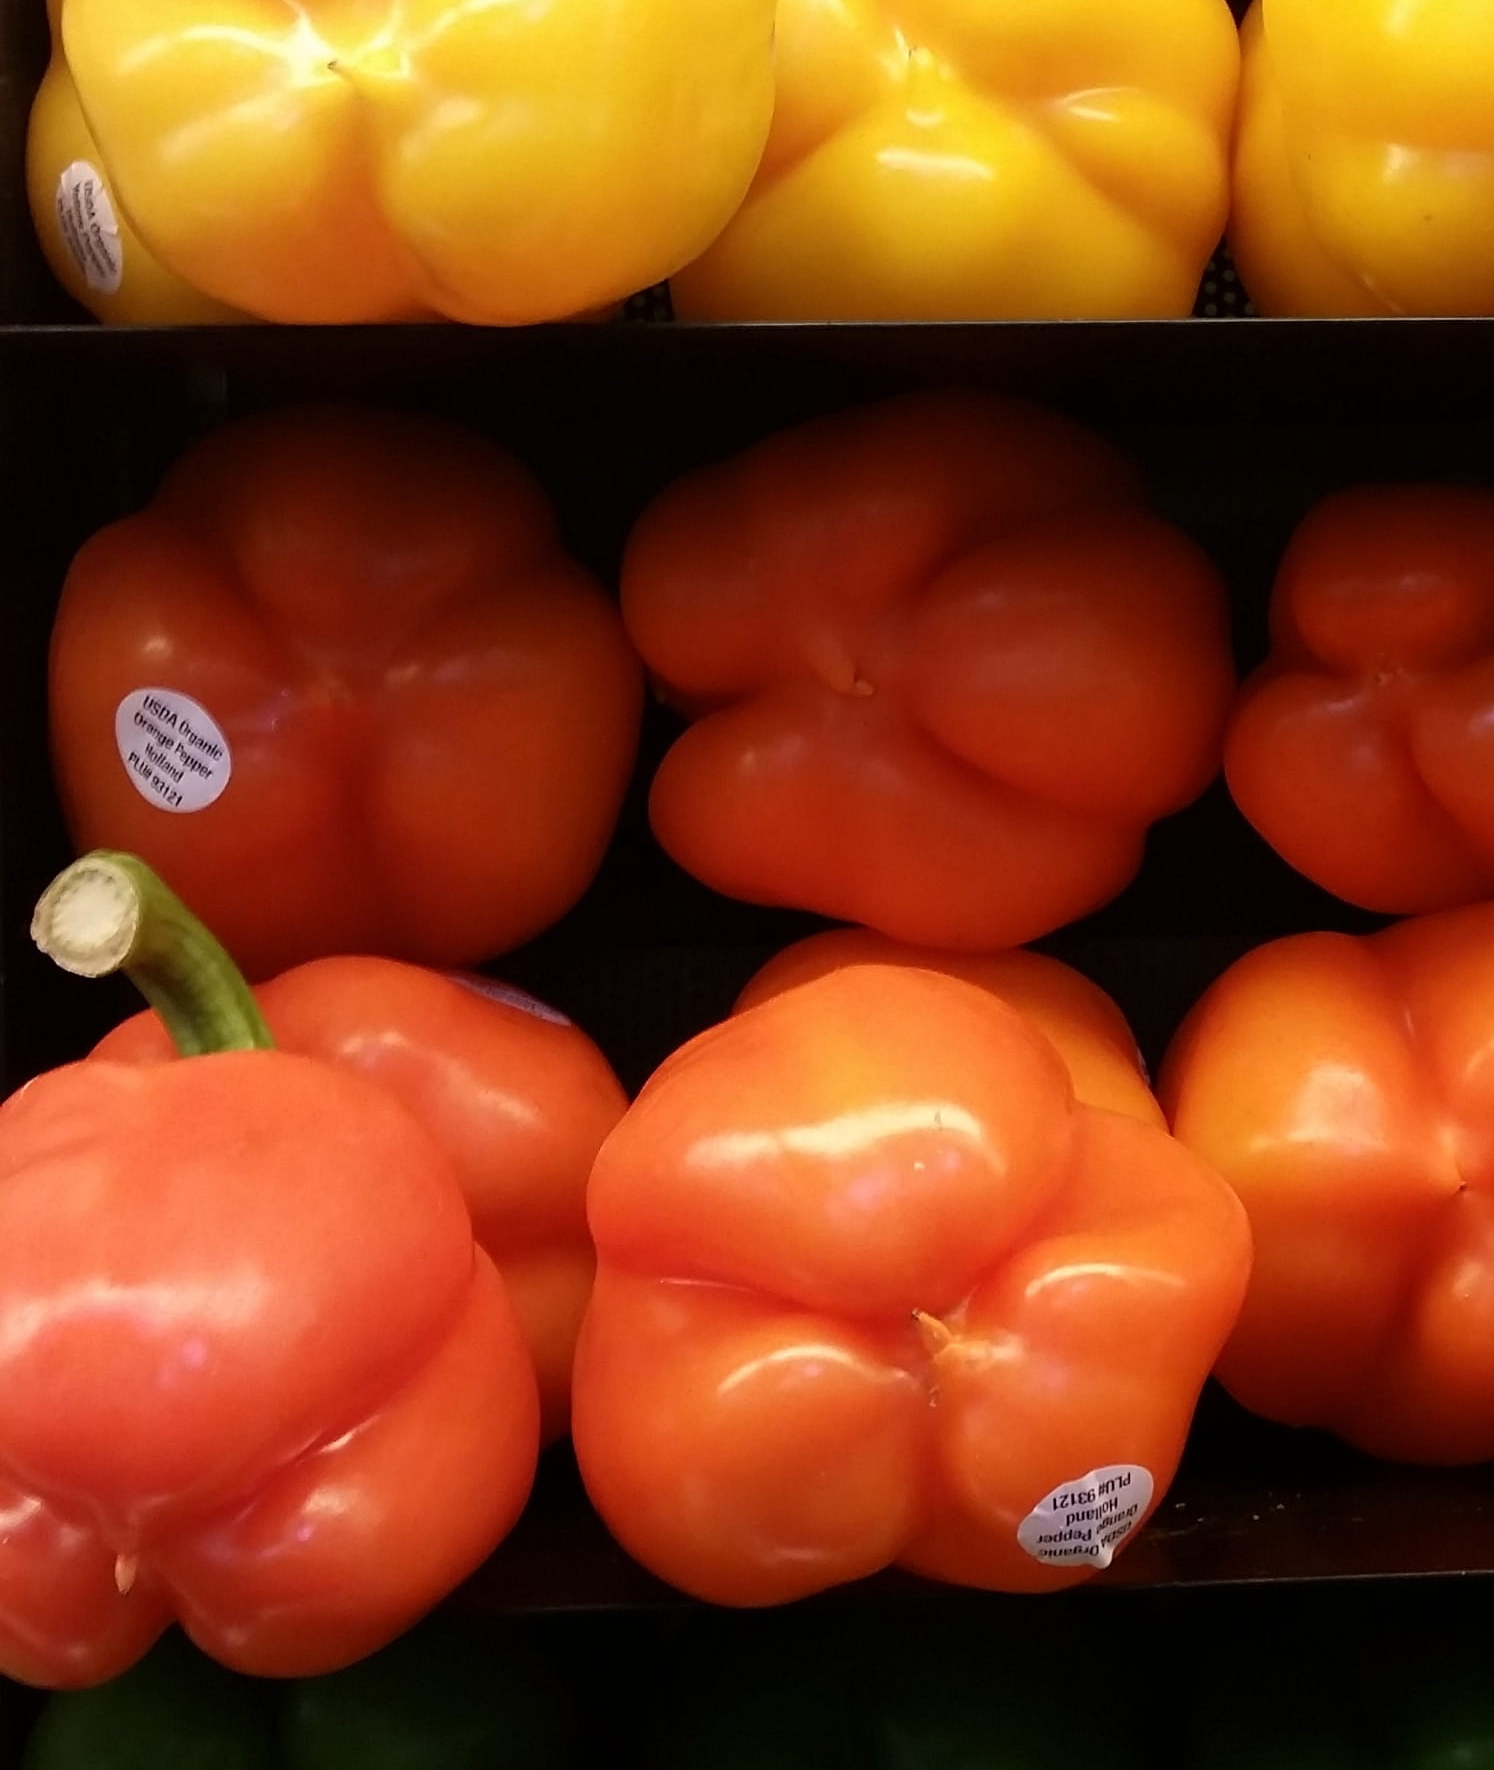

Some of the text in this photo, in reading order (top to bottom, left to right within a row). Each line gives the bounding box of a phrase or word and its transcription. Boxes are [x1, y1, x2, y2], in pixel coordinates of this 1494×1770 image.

[133, 711, 214, 780] Orange Pepper
[142, 695, 224, 761] USDA Organic
[127, 751, 183, 807] PLU# 93121
[144, 742, 184, 784] Holland
[1052, 1472, 1132, 1511] PLU# 93121
[1065, 1497, 1118, 1527] Holland
[1036, 1503, 1138, 1544] Orange Pepper
[1038, 1543, 1100, 1559] Organic
